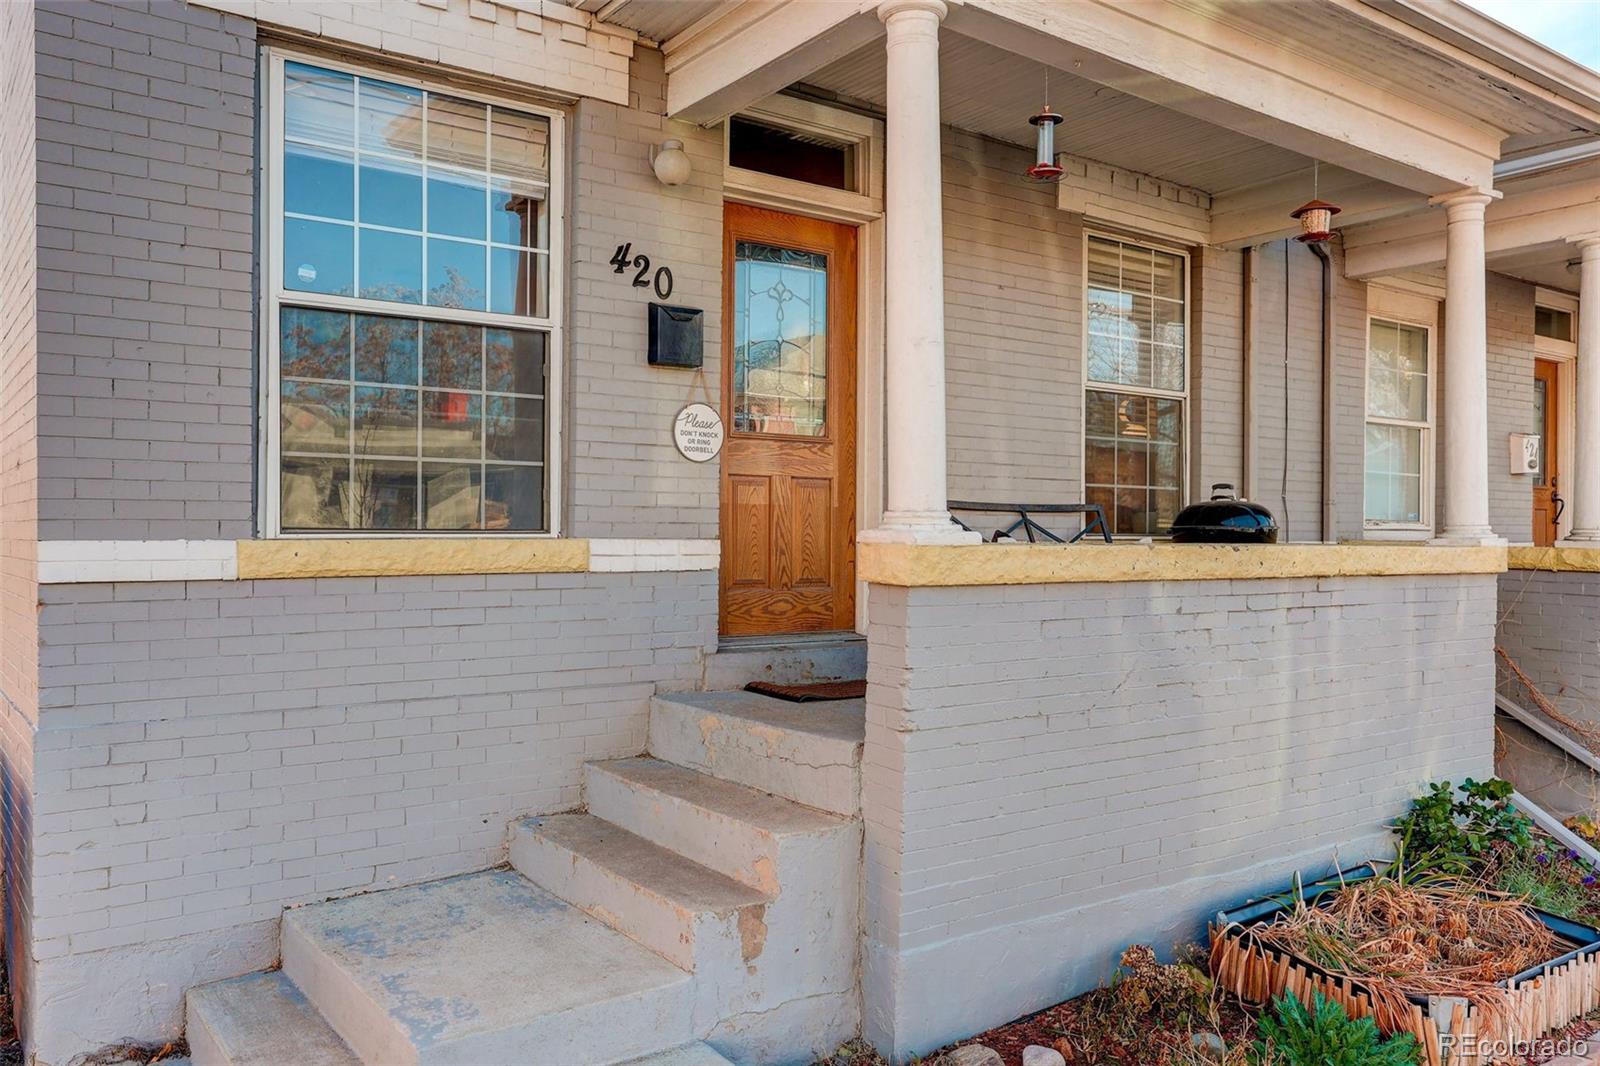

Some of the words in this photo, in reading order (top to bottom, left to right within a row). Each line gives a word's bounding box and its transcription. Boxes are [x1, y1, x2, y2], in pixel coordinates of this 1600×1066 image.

[609, 243, 673, 299] 420
[677, 411, 721, 430] Please
[680, 429, 698, 437] DON'T
[698, 431, 719, 439] KNOCK
[696, 438, 711, 446] RING
[684, 445, 714, 454] DOORBELL
